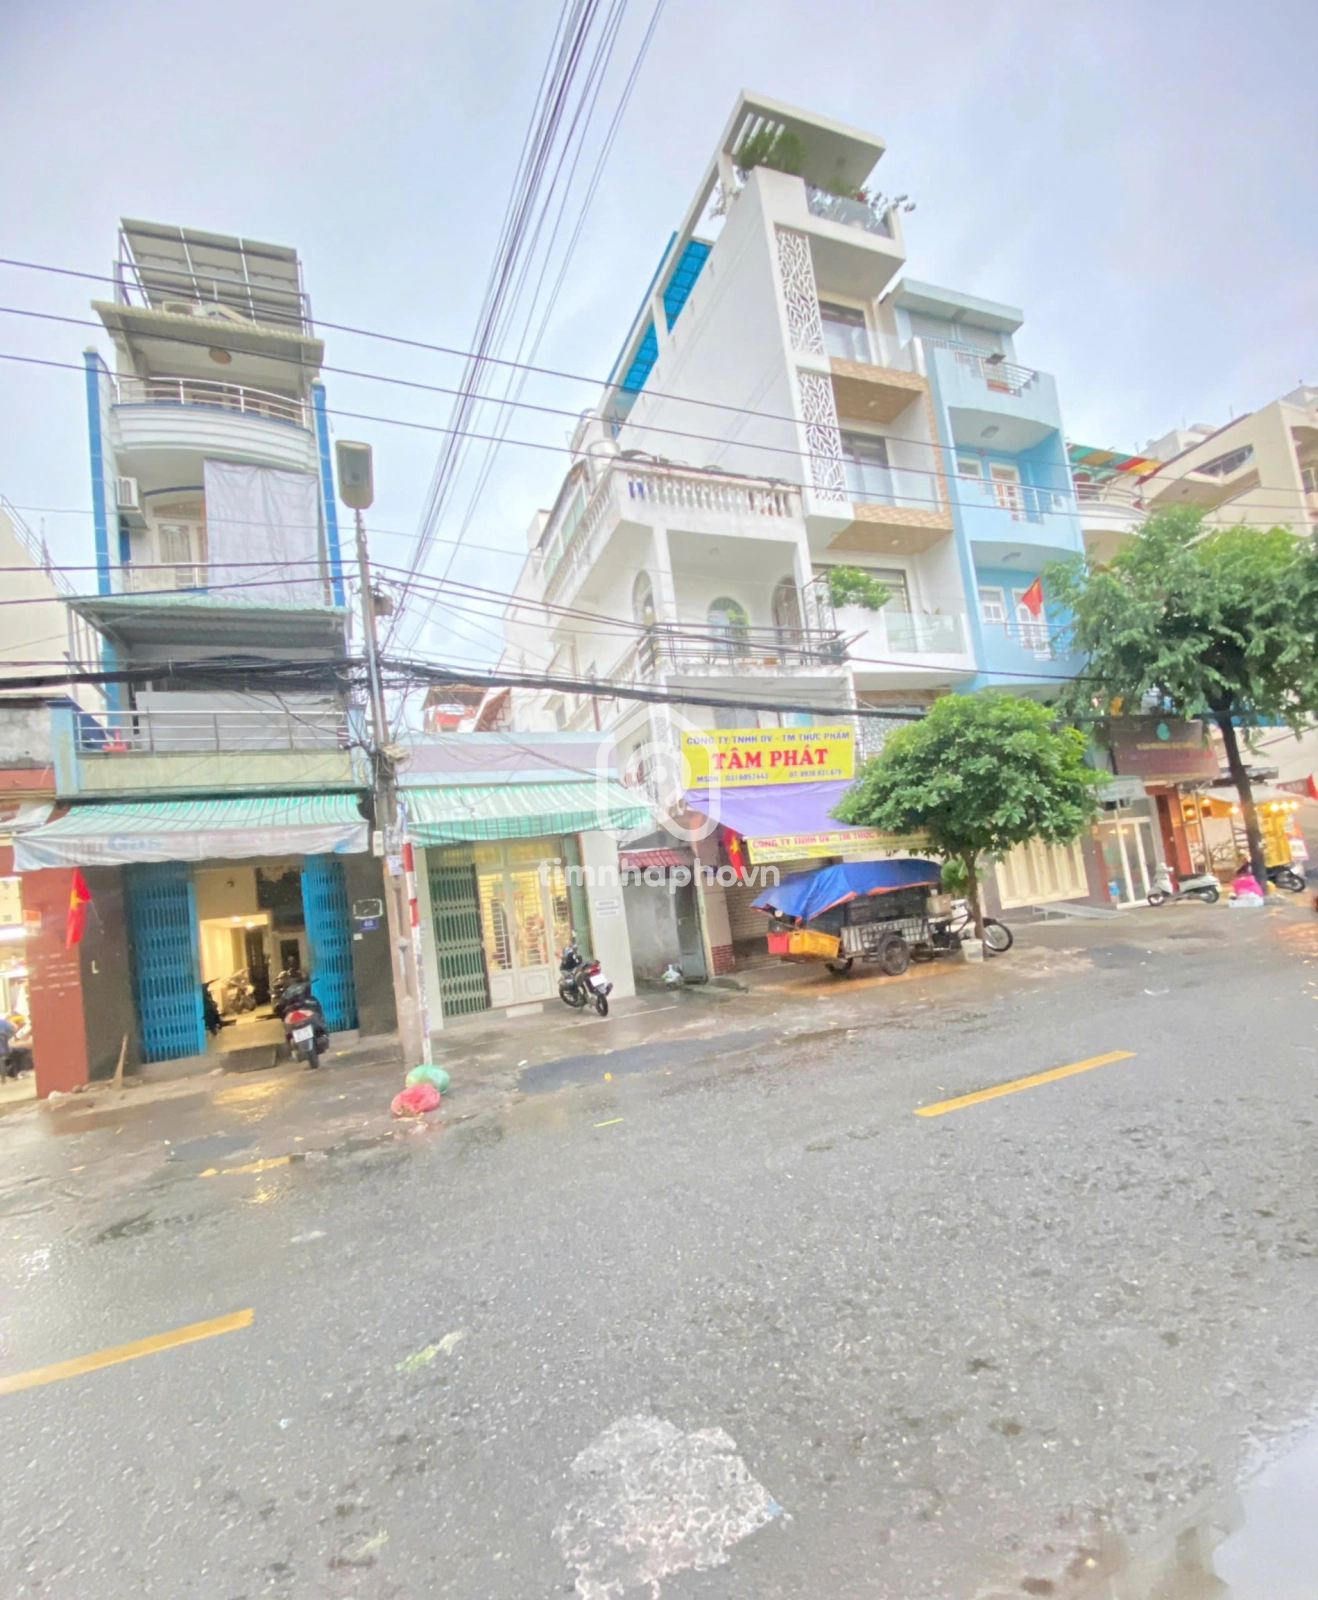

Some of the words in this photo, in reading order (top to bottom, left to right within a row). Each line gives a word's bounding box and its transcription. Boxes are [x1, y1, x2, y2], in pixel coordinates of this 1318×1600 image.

[718, 736, 729, 745] TY
[732, 735, 758, 744] TNHH
[782, 734, 796, 742] TM
[712, 747, 762, 770] TÂM
[770, 744, 828, 767] PHÁT
